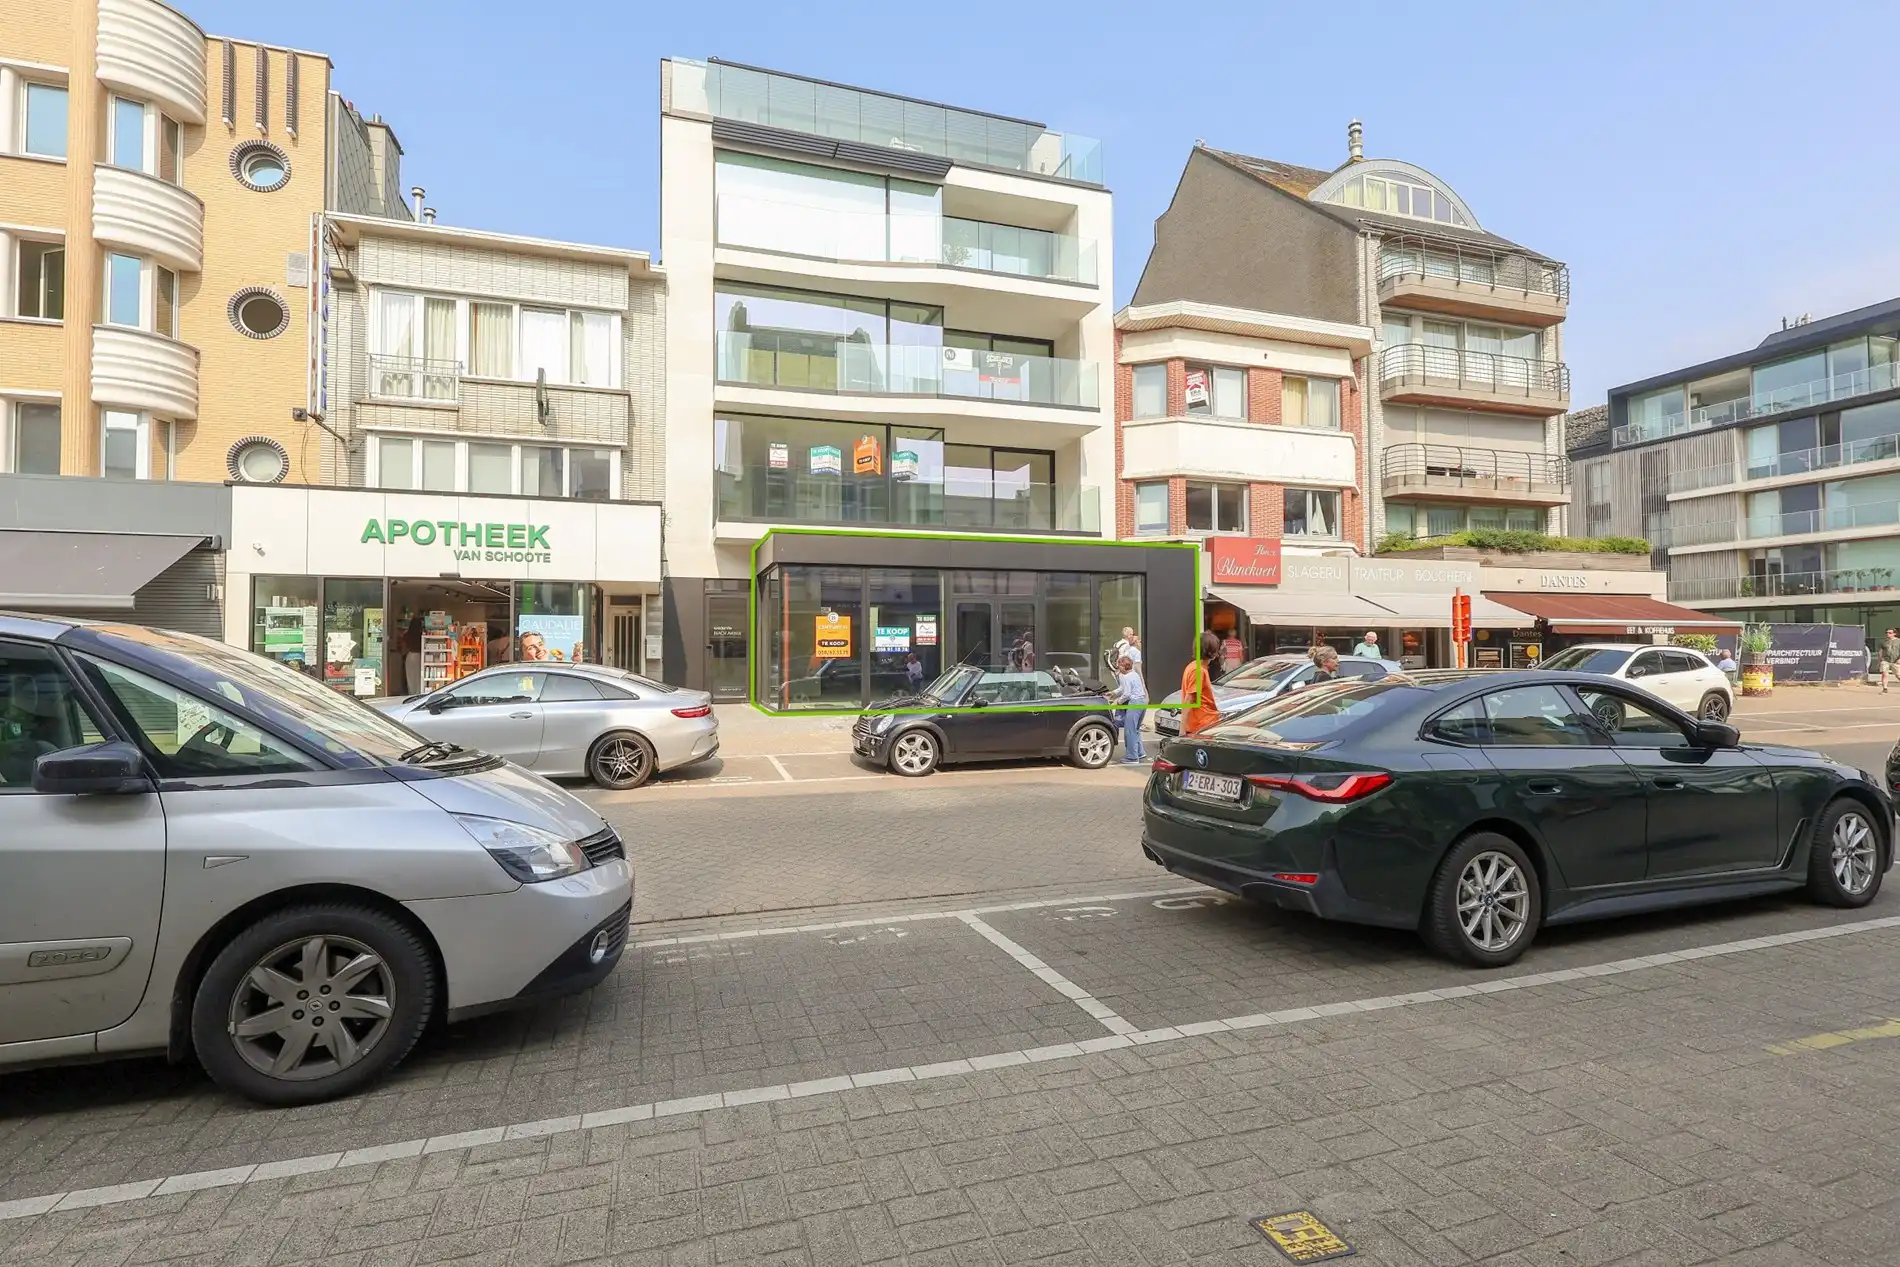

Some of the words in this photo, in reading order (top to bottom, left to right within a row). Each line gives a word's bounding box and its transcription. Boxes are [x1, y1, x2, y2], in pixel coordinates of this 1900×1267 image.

[360, 518, 551, 550] APOTHEEK
[453, 549, 481, 561] VAN
[485, 550, 551, 563] SCHOOTE
[1287, 565, 1342, 580] SLAGERIJ
[1355, 567, 1405, 582] TRAITEUR
[1415, 570, 1474, 583] BOUCHERIE
[1540, 575, 1588, 588] DANTES
[522, 619, 581, 631] CAUDALIE
[876, 627, 886, 635] TE
[887, 627, 909, 635] KOOP
[1512, 629, 1543, 638] Dantes
[1766, 657, 1801, 665] VERBINDT
